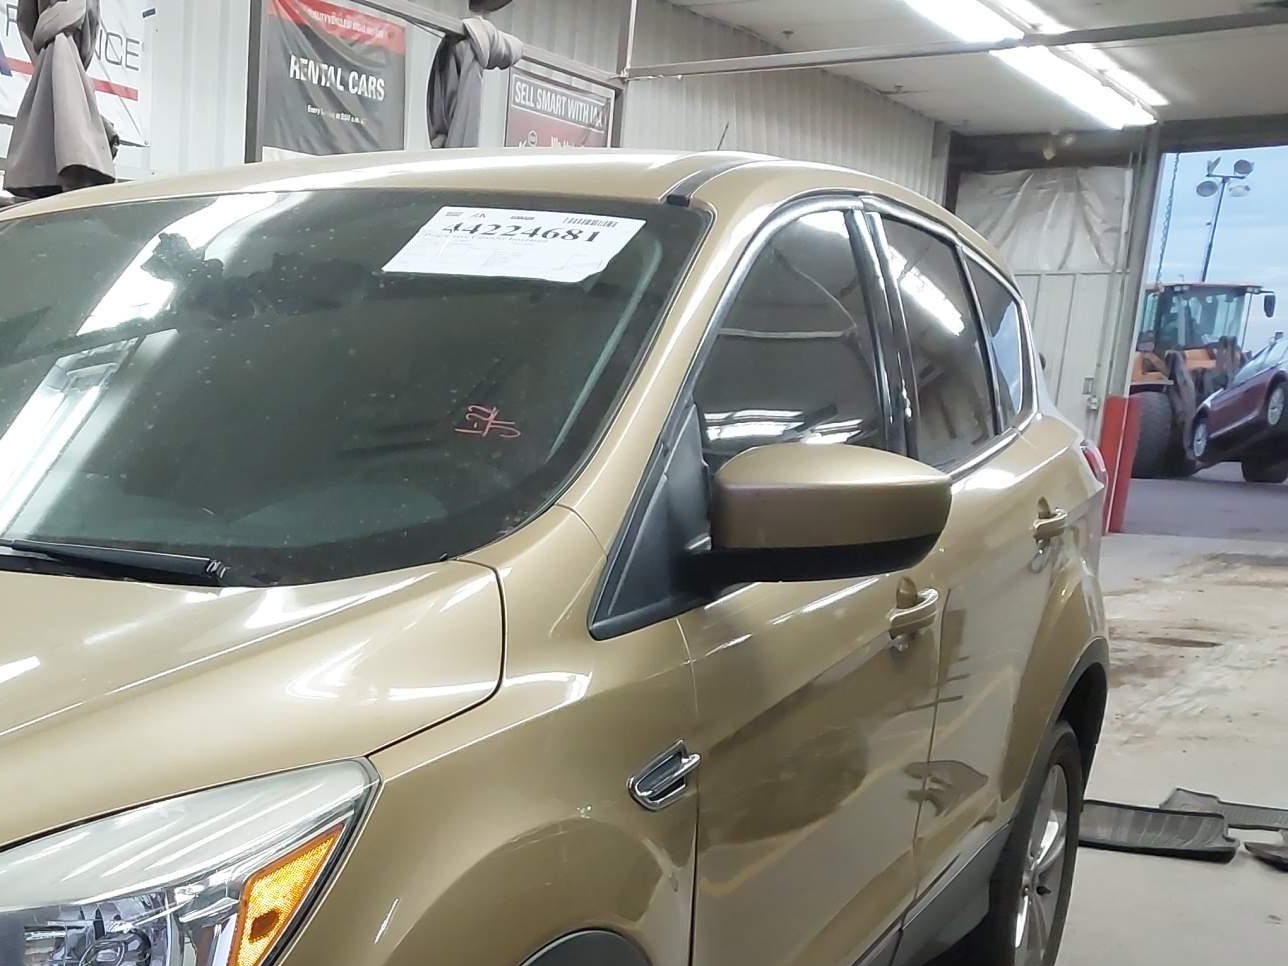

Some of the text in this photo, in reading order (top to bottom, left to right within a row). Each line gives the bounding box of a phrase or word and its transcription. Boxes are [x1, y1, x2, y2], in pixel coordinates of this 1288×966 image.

[289, 54, 385, 101] RENTAL CARS
[515, 81, 535, 108] SELL
[536, 88, 567, 119] SMART
[567, 98, 588, 124] WITH
[442, 222, 601, 243] 44224681
